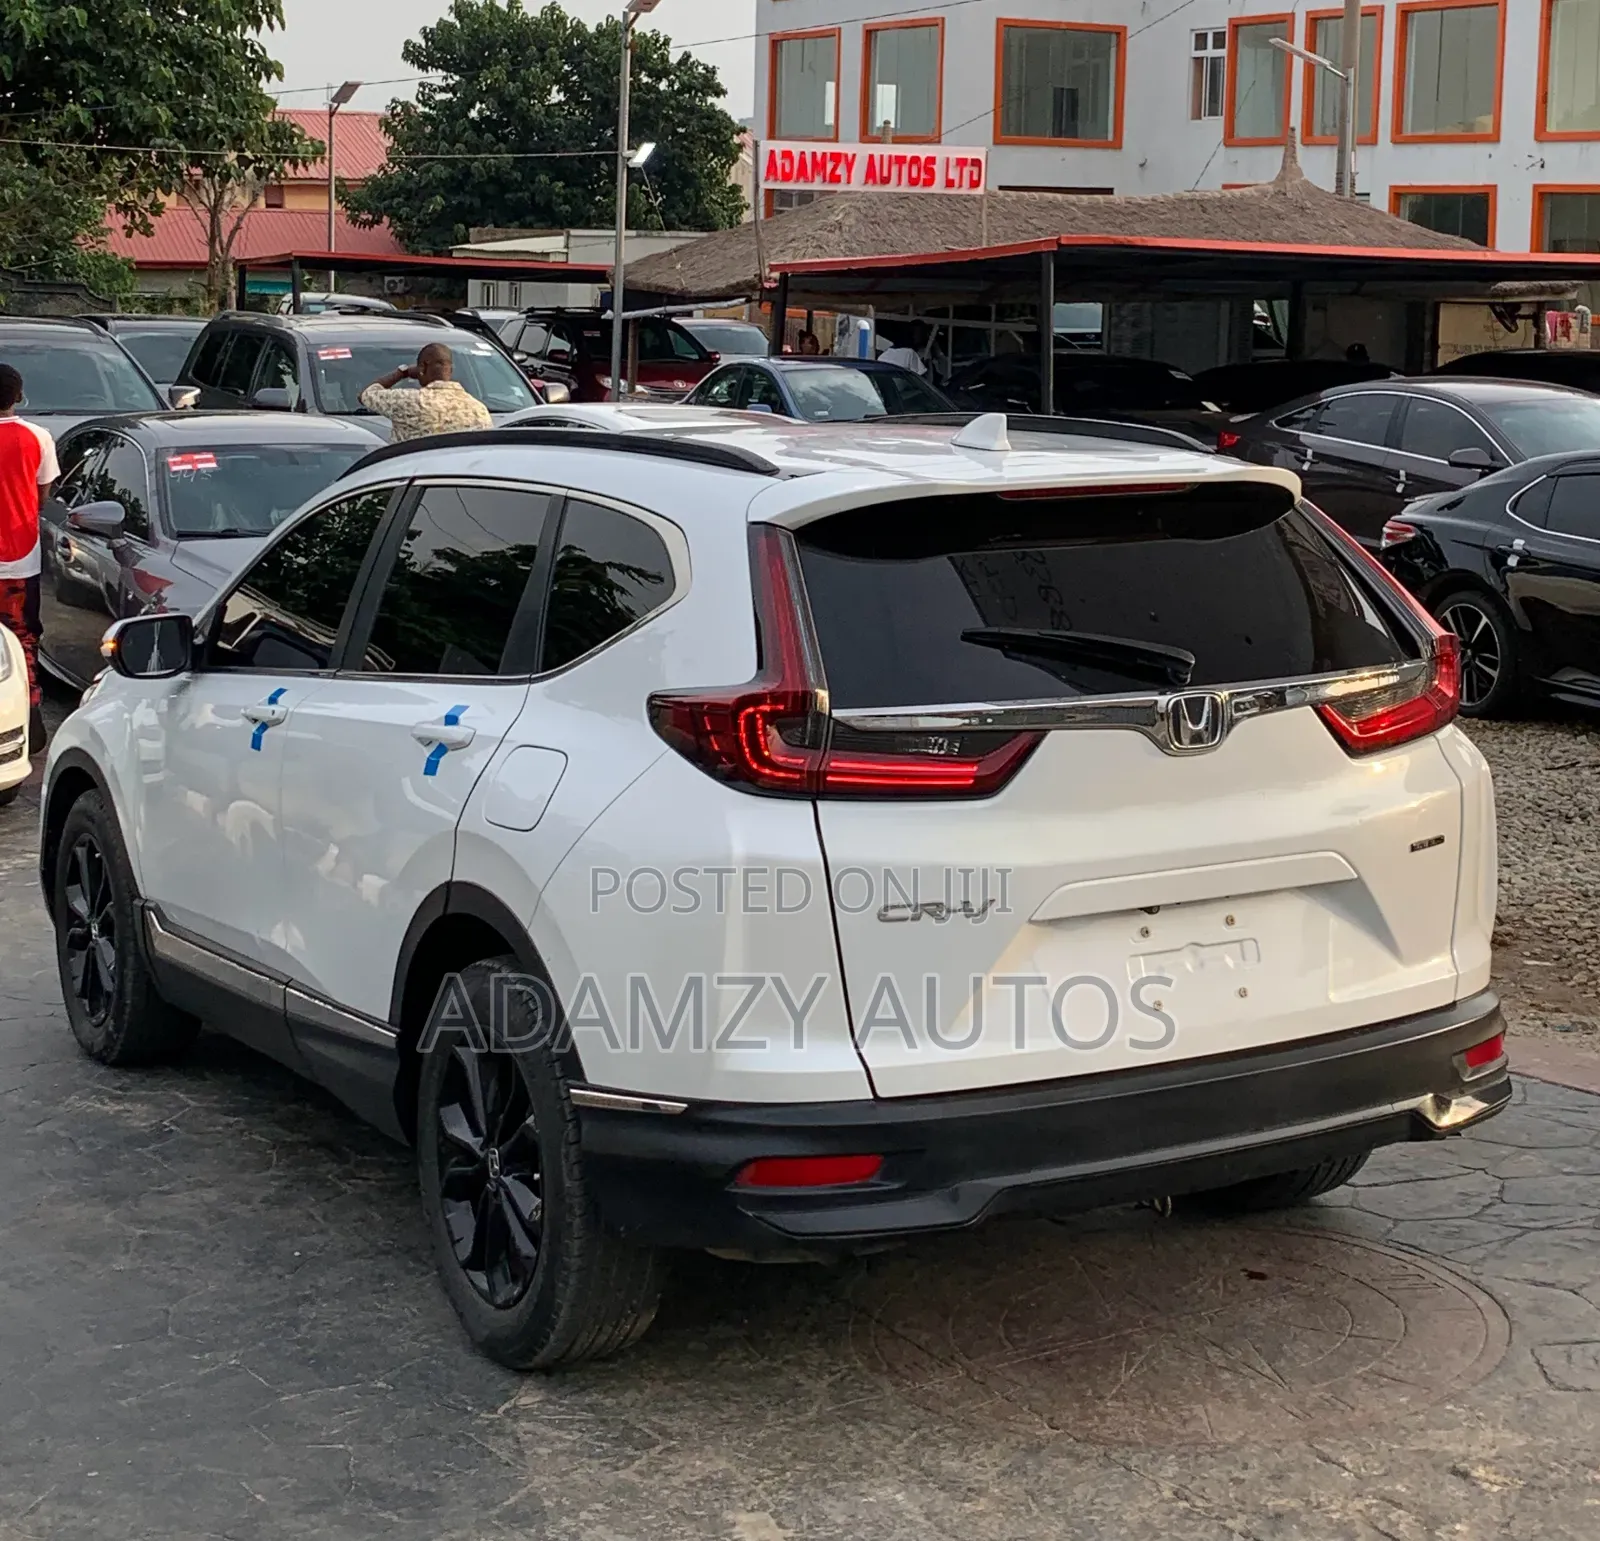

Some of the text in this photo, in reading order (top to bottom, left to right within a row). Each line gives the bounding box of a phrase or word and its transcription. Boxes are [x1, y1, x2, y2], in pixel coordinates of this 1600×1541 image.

[764, 149, 983, 189] ADAMZY AUTOS LTD
